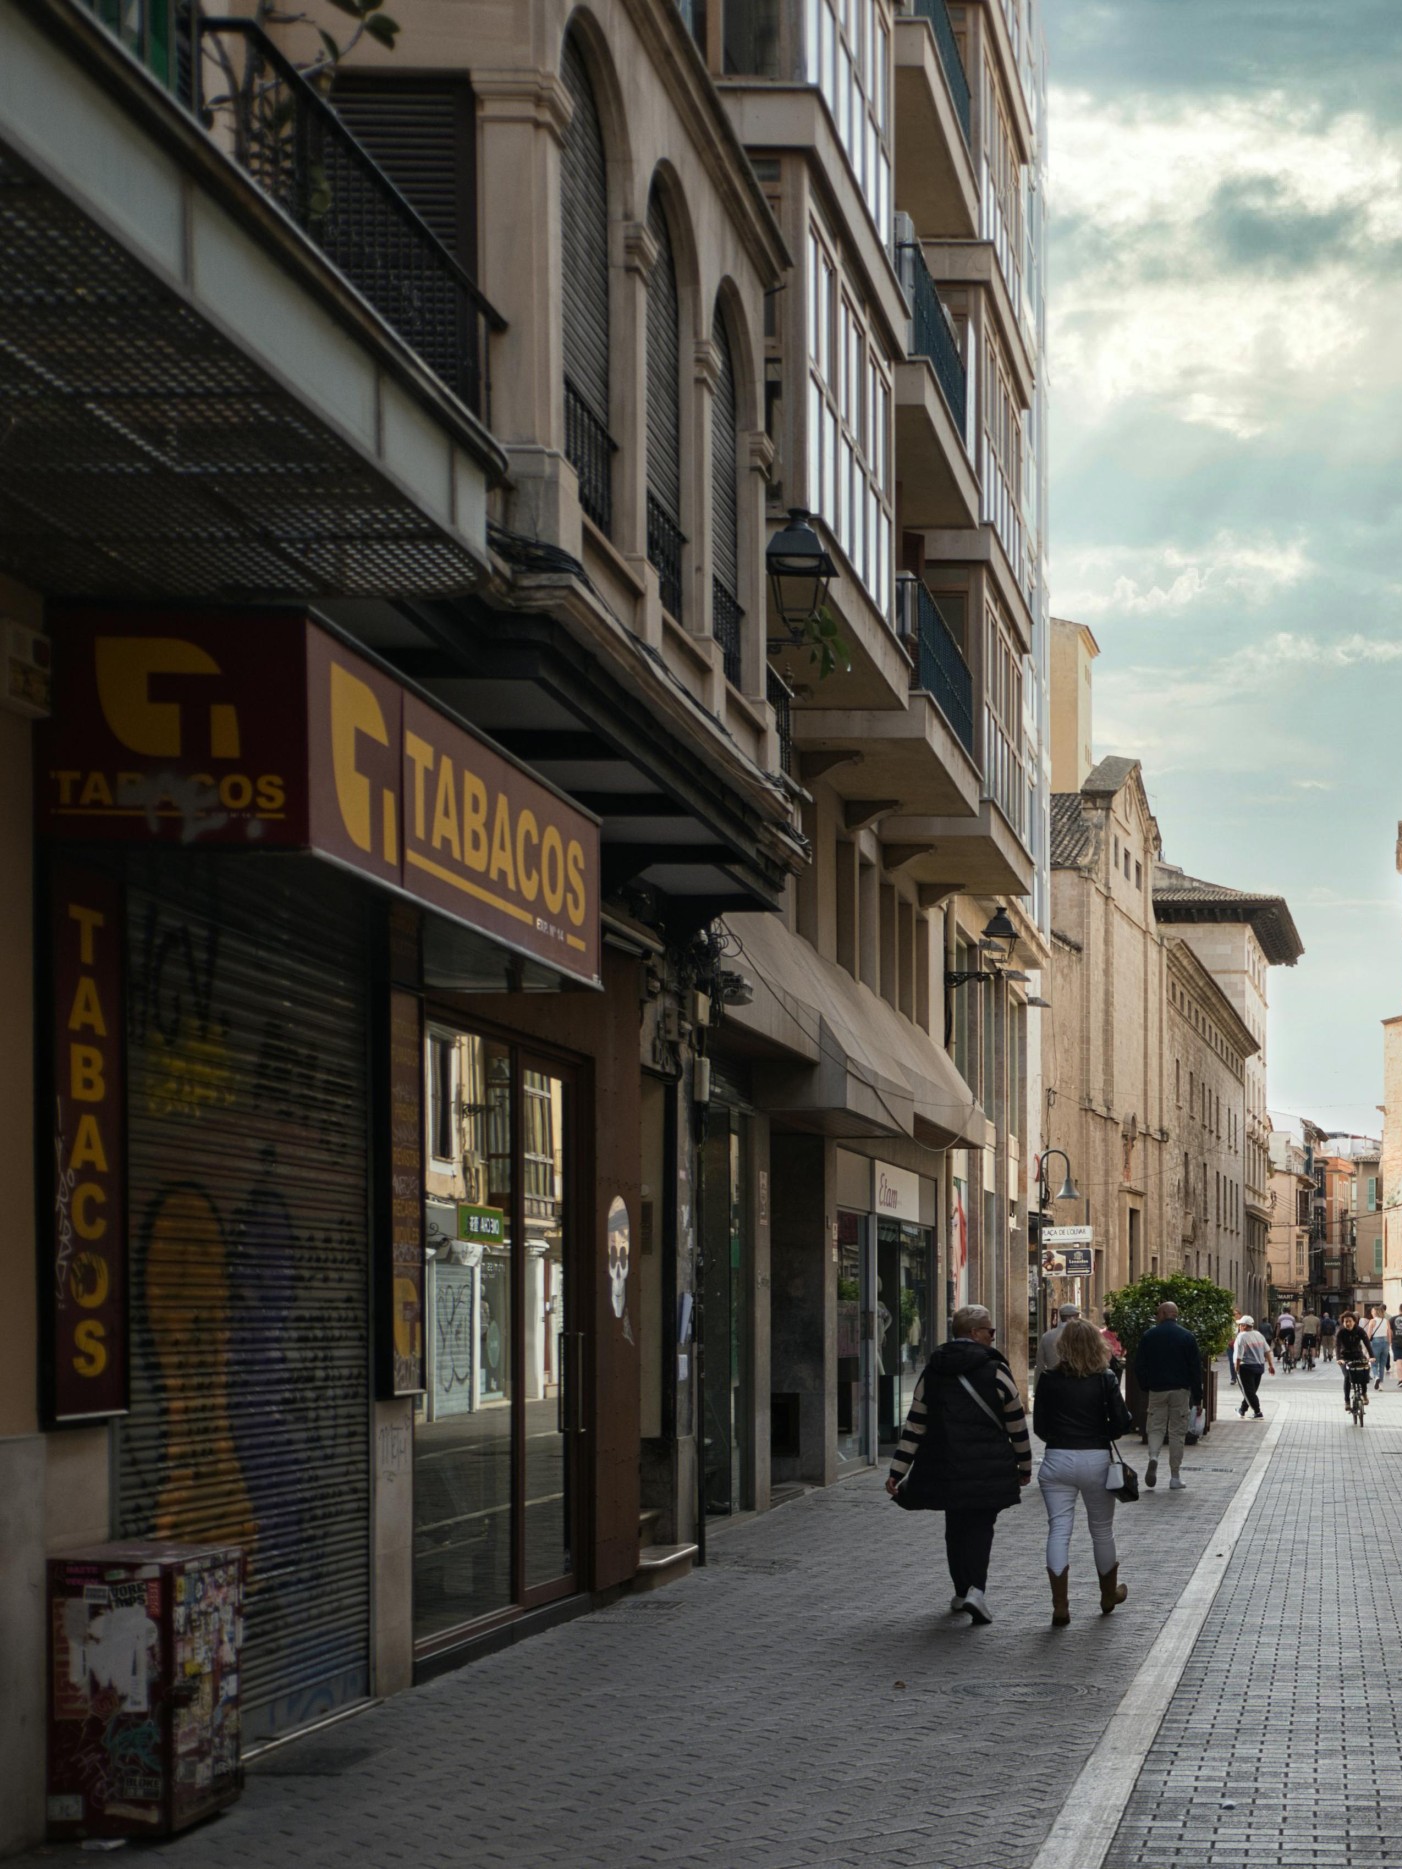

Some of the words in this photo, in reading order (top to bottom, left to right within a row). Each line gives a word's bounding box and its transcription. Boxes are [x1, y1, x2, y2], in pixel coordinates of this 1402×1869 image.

[55, 770, 287, 810] TABCOS
[405, 729, 586, 926] TABACOS
[67, 904, 110, 1379] TABACOS
[879, 1172, 898, 1209] Etam
